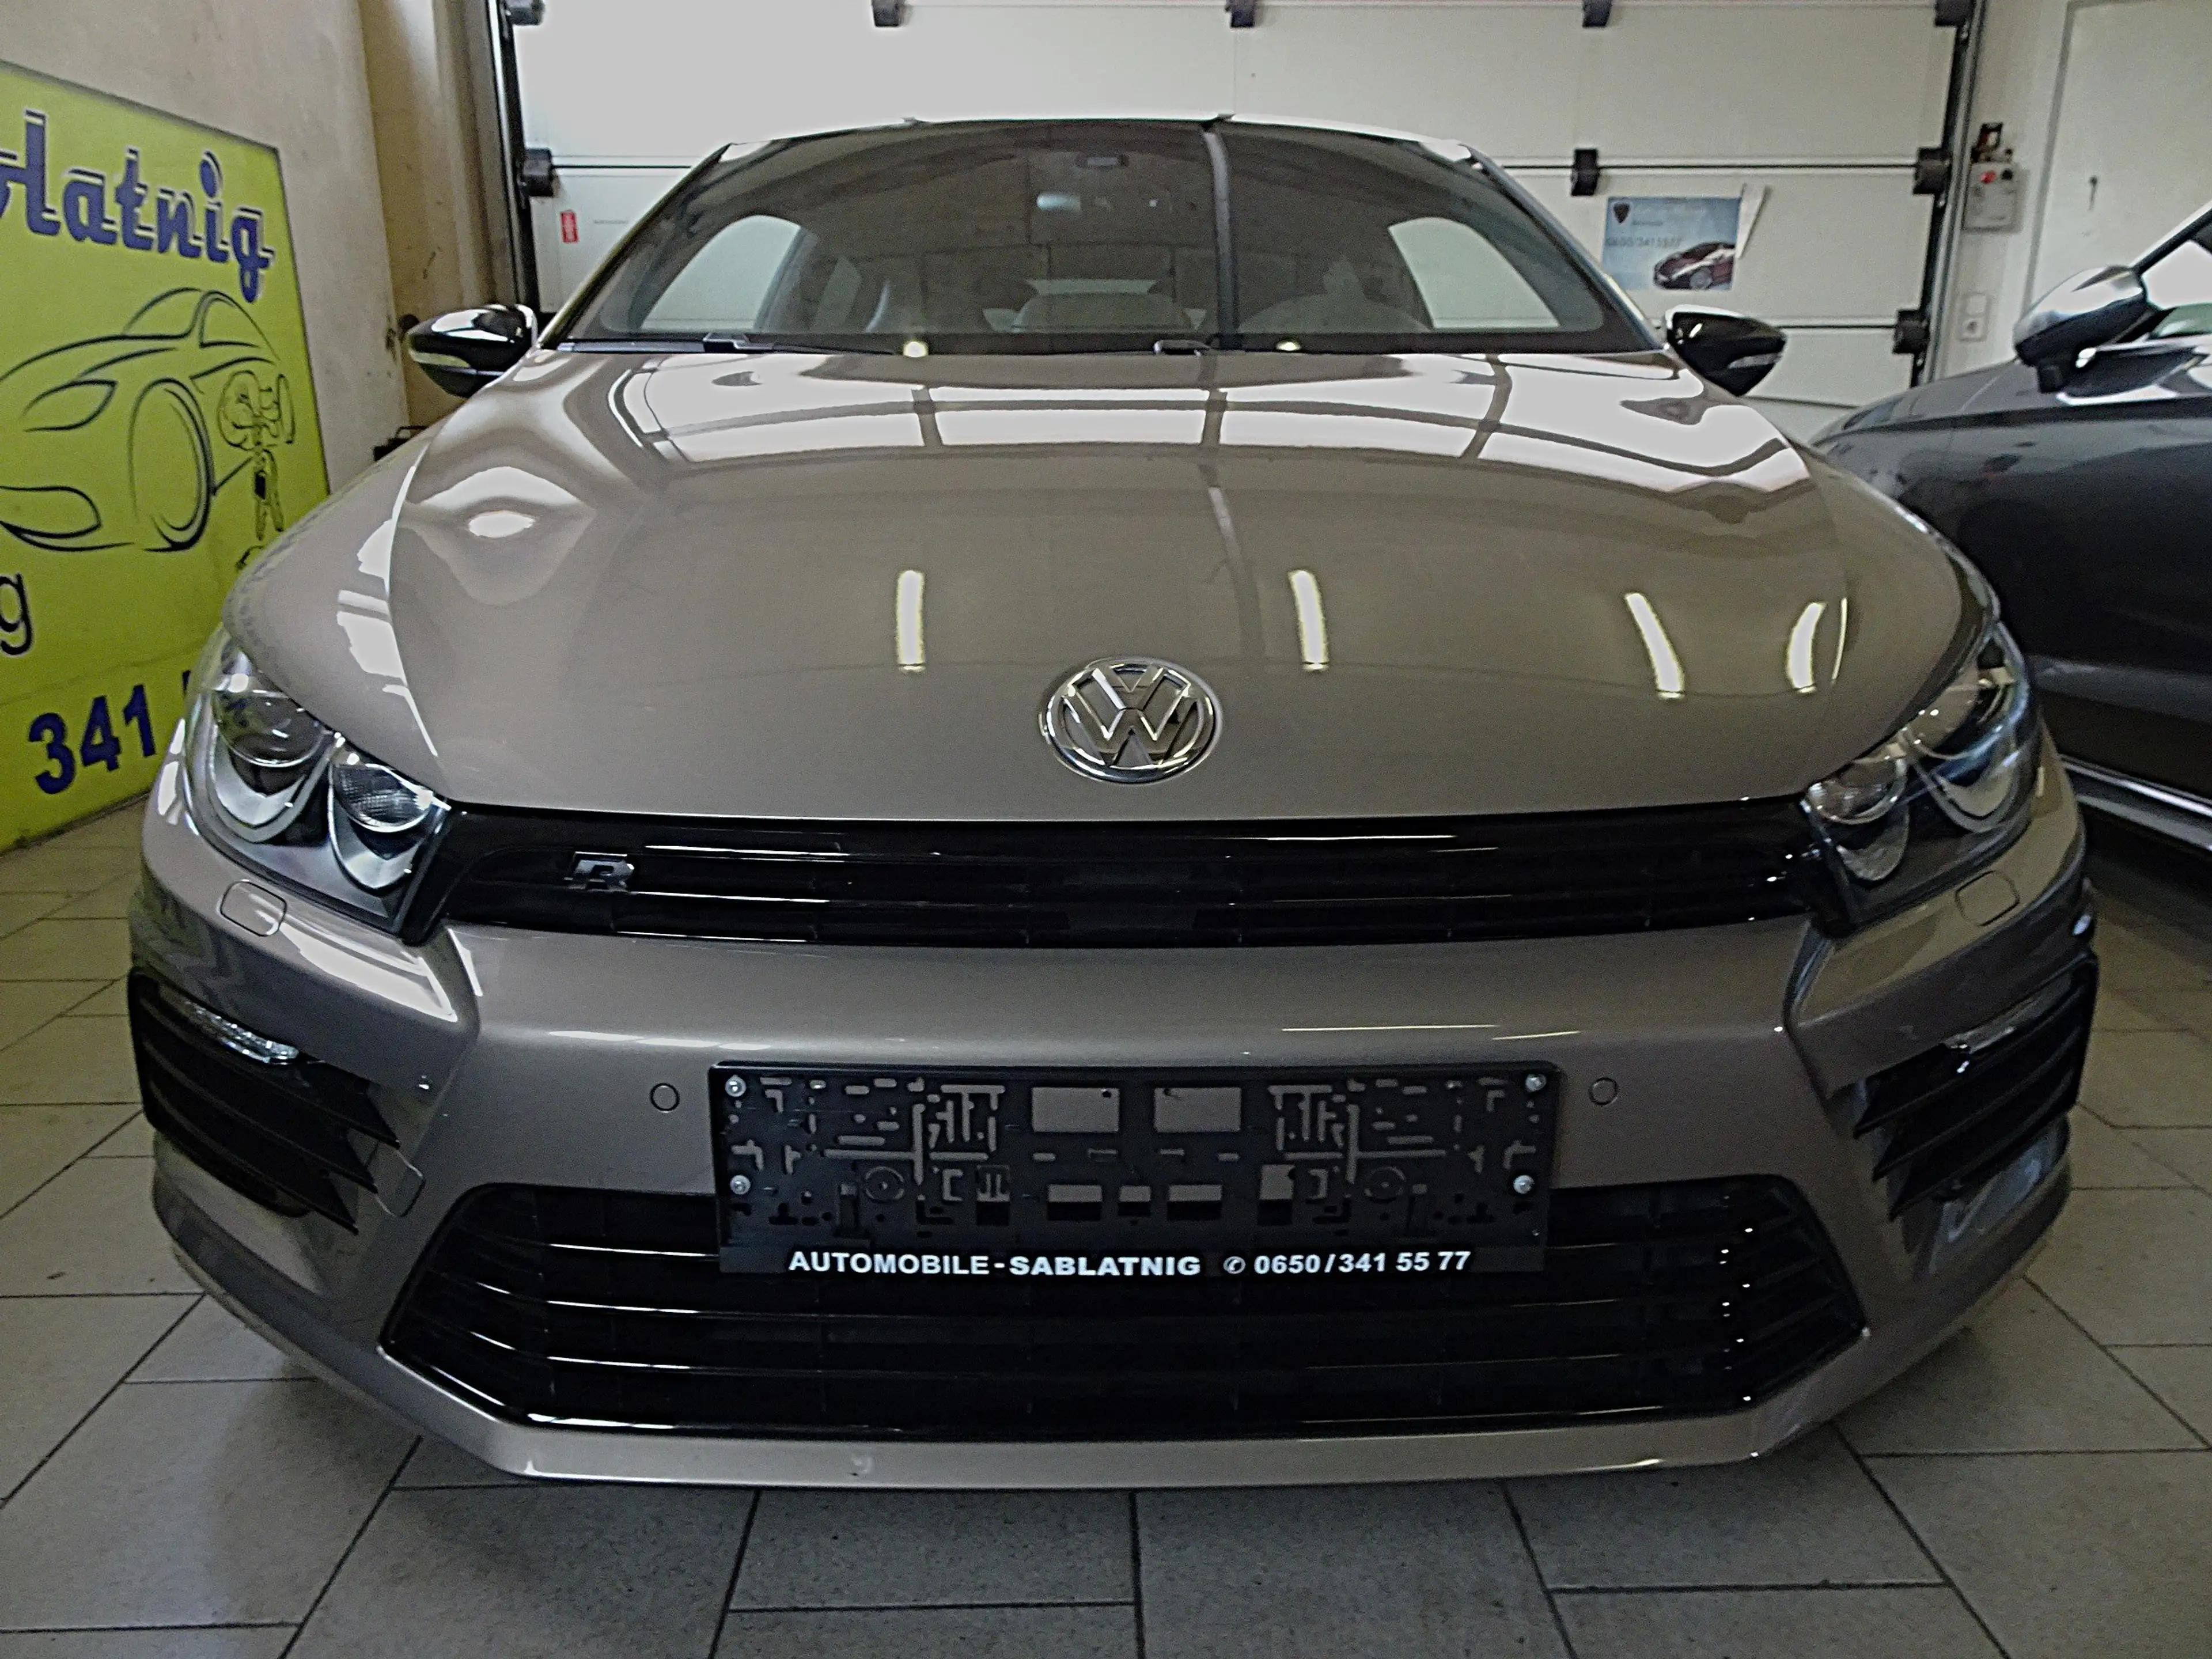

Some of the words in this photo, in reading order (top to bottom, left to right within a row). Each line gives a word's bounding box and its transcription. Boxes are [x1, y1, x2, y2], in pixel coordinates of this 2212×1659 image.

[28, 683, 157, 794] 341
[1047, 660, 1215, 778] VW
[565, 851, 634, 892] R
[788, 1251, 1201, 1277] AUTOMOBILE-SABLATNIG
[1396, 1251, 1430, 1272] 55
[1438, 1251, 1472, 1271] 77
